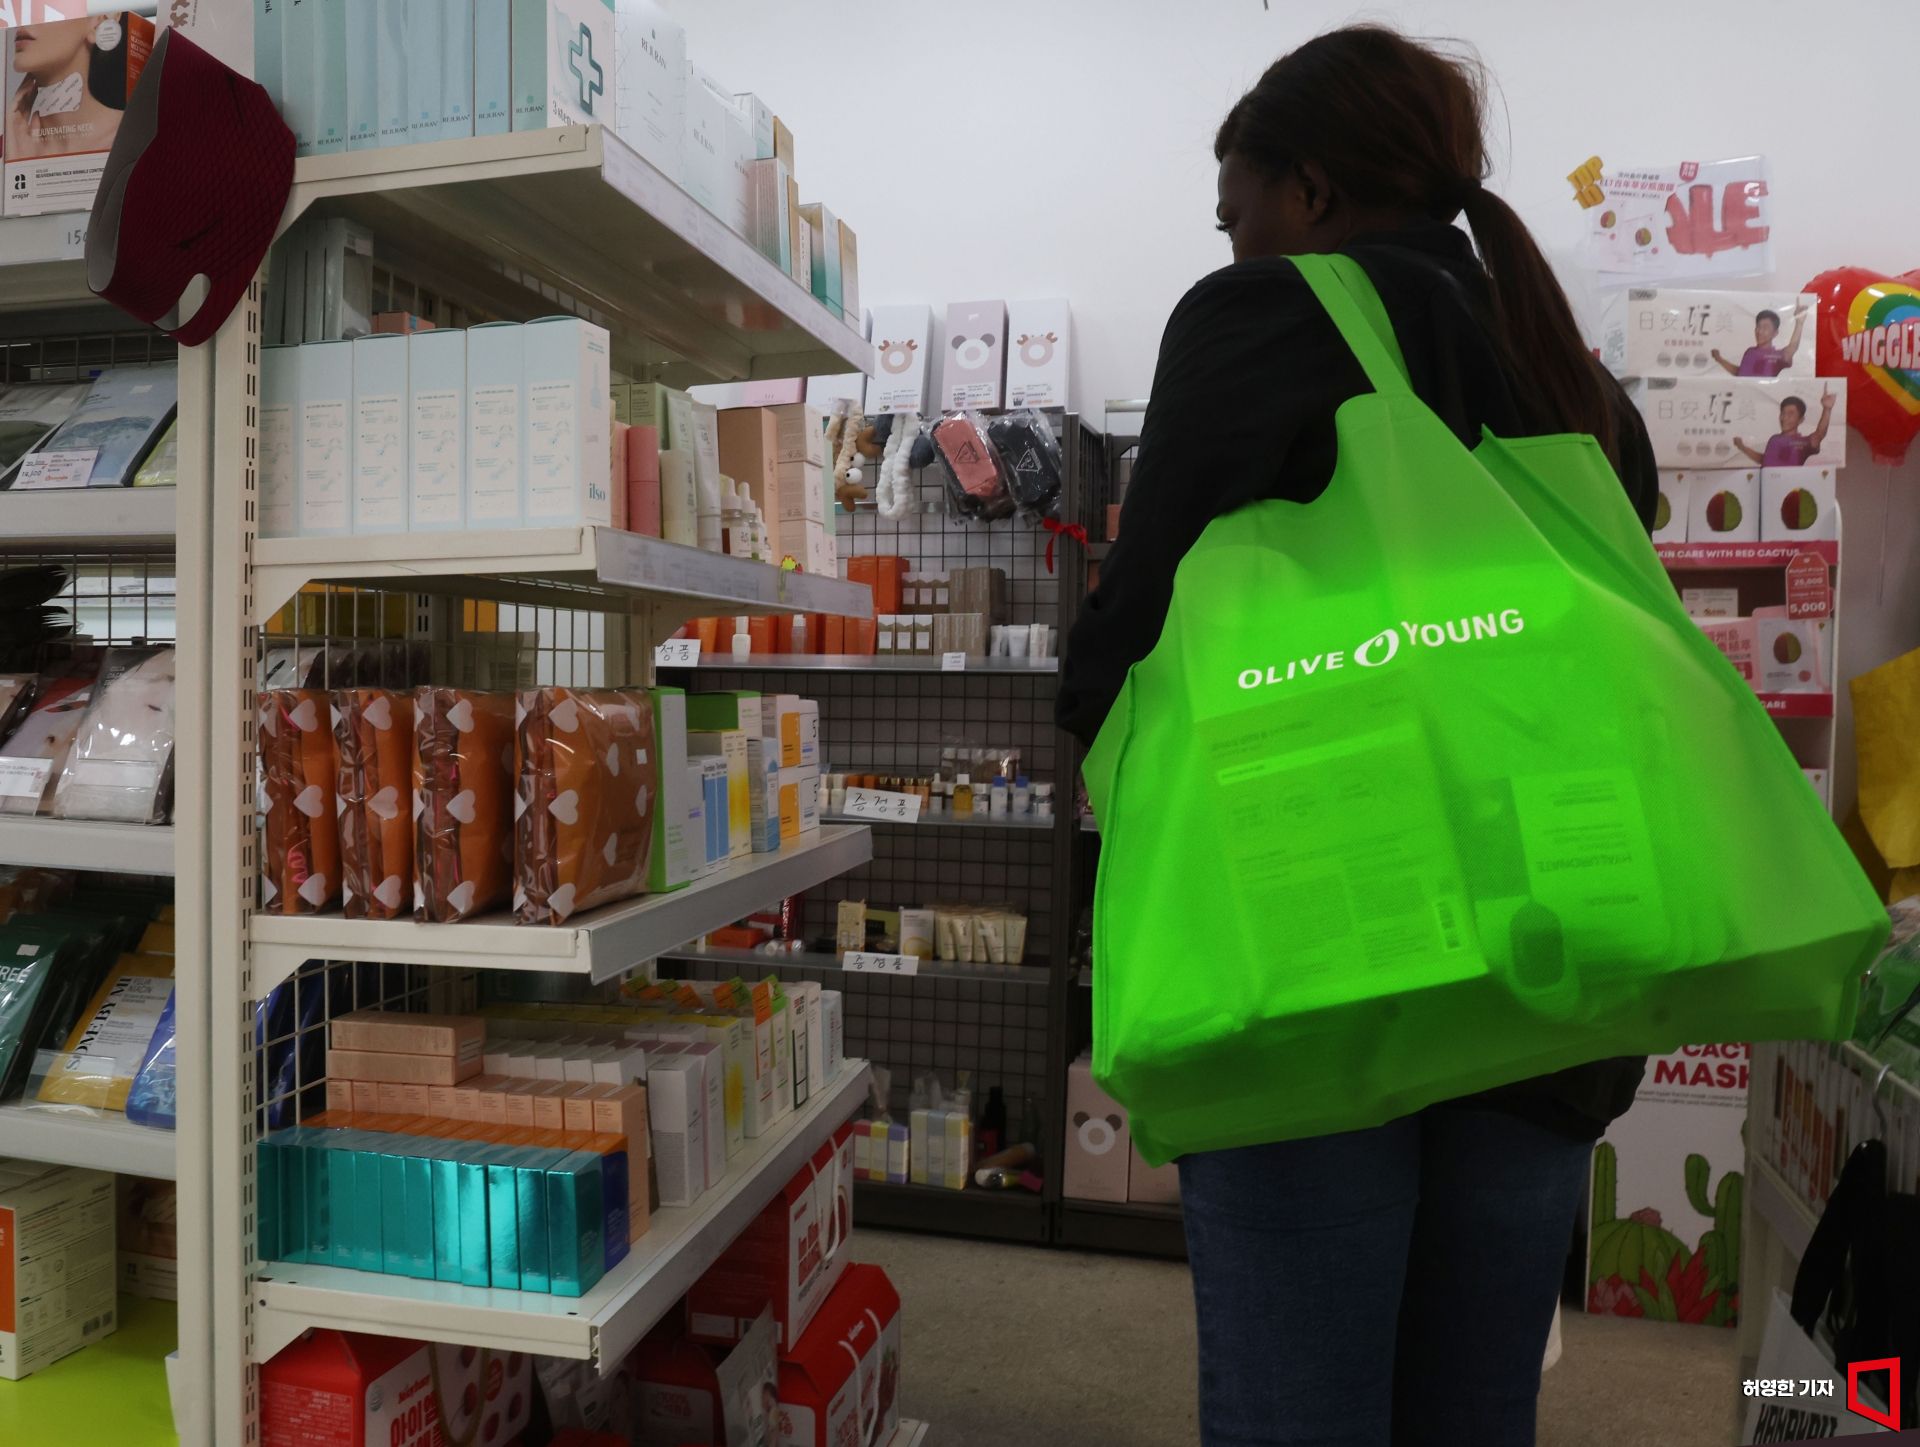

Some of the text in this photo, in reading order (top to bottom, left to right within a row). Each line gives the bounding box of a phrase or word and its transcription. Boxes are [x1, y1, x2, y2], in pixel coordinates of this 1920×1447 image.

[589, 483, 606, 501] ilso
[1656, 549, 1675, 559] KIN
[1676, 549, 1704, 559] CARE
[1706, 548, 1734, 558] WITH
[1736, 547, 1755, 558] RED
[1789, 601, 1826, 616] 5,000
[1237, 651, 1344, 690] OLIVE
[1400, 608, 1525, 648] YOUNG
[0, 965, 31, 984] REE
